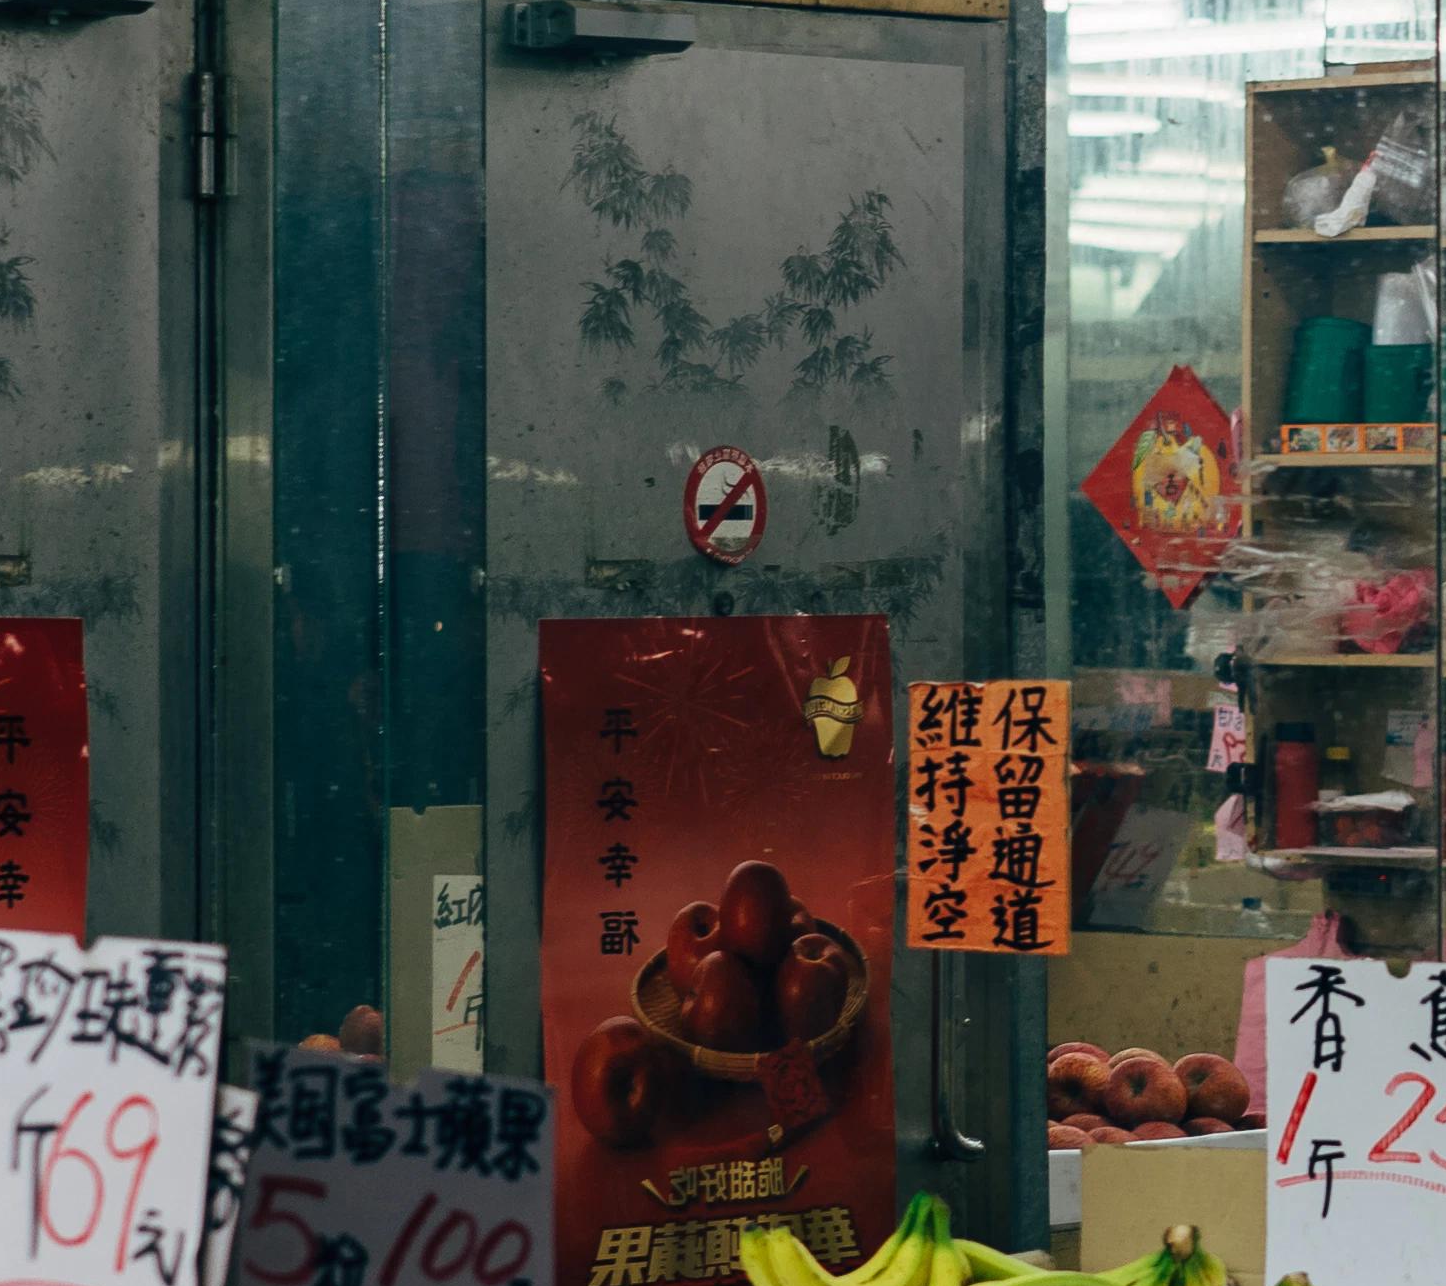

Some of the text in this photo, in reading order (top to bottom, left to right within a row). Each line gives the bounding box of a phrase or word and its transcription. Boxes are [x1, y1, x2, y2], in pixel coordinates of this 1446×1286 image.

[912, 684, 982, 947] 維持淨空
[989, 683, 1055, 954] 保留通道
